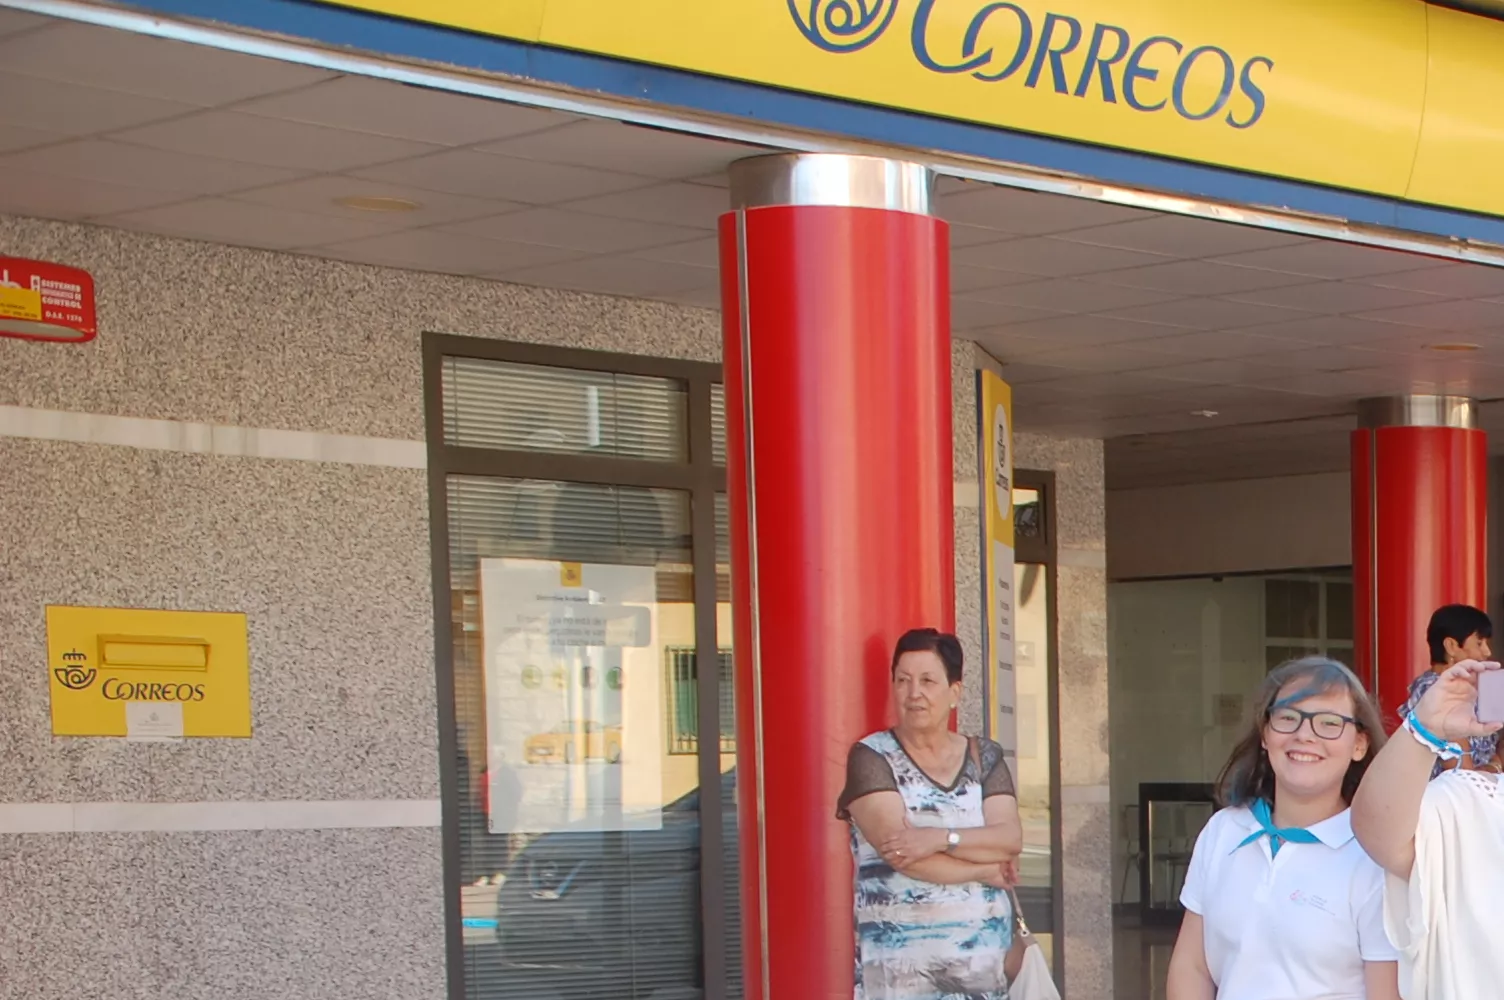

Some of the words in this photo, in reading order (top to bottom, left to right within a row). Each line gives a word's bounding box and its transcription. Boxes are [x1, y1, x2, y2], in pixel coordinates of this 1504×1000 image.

[910, 0, 1274, 130] CORREOS
[42, 296, 82, 309] CONTROL
[102, 678, 205, 702] CORREOS
